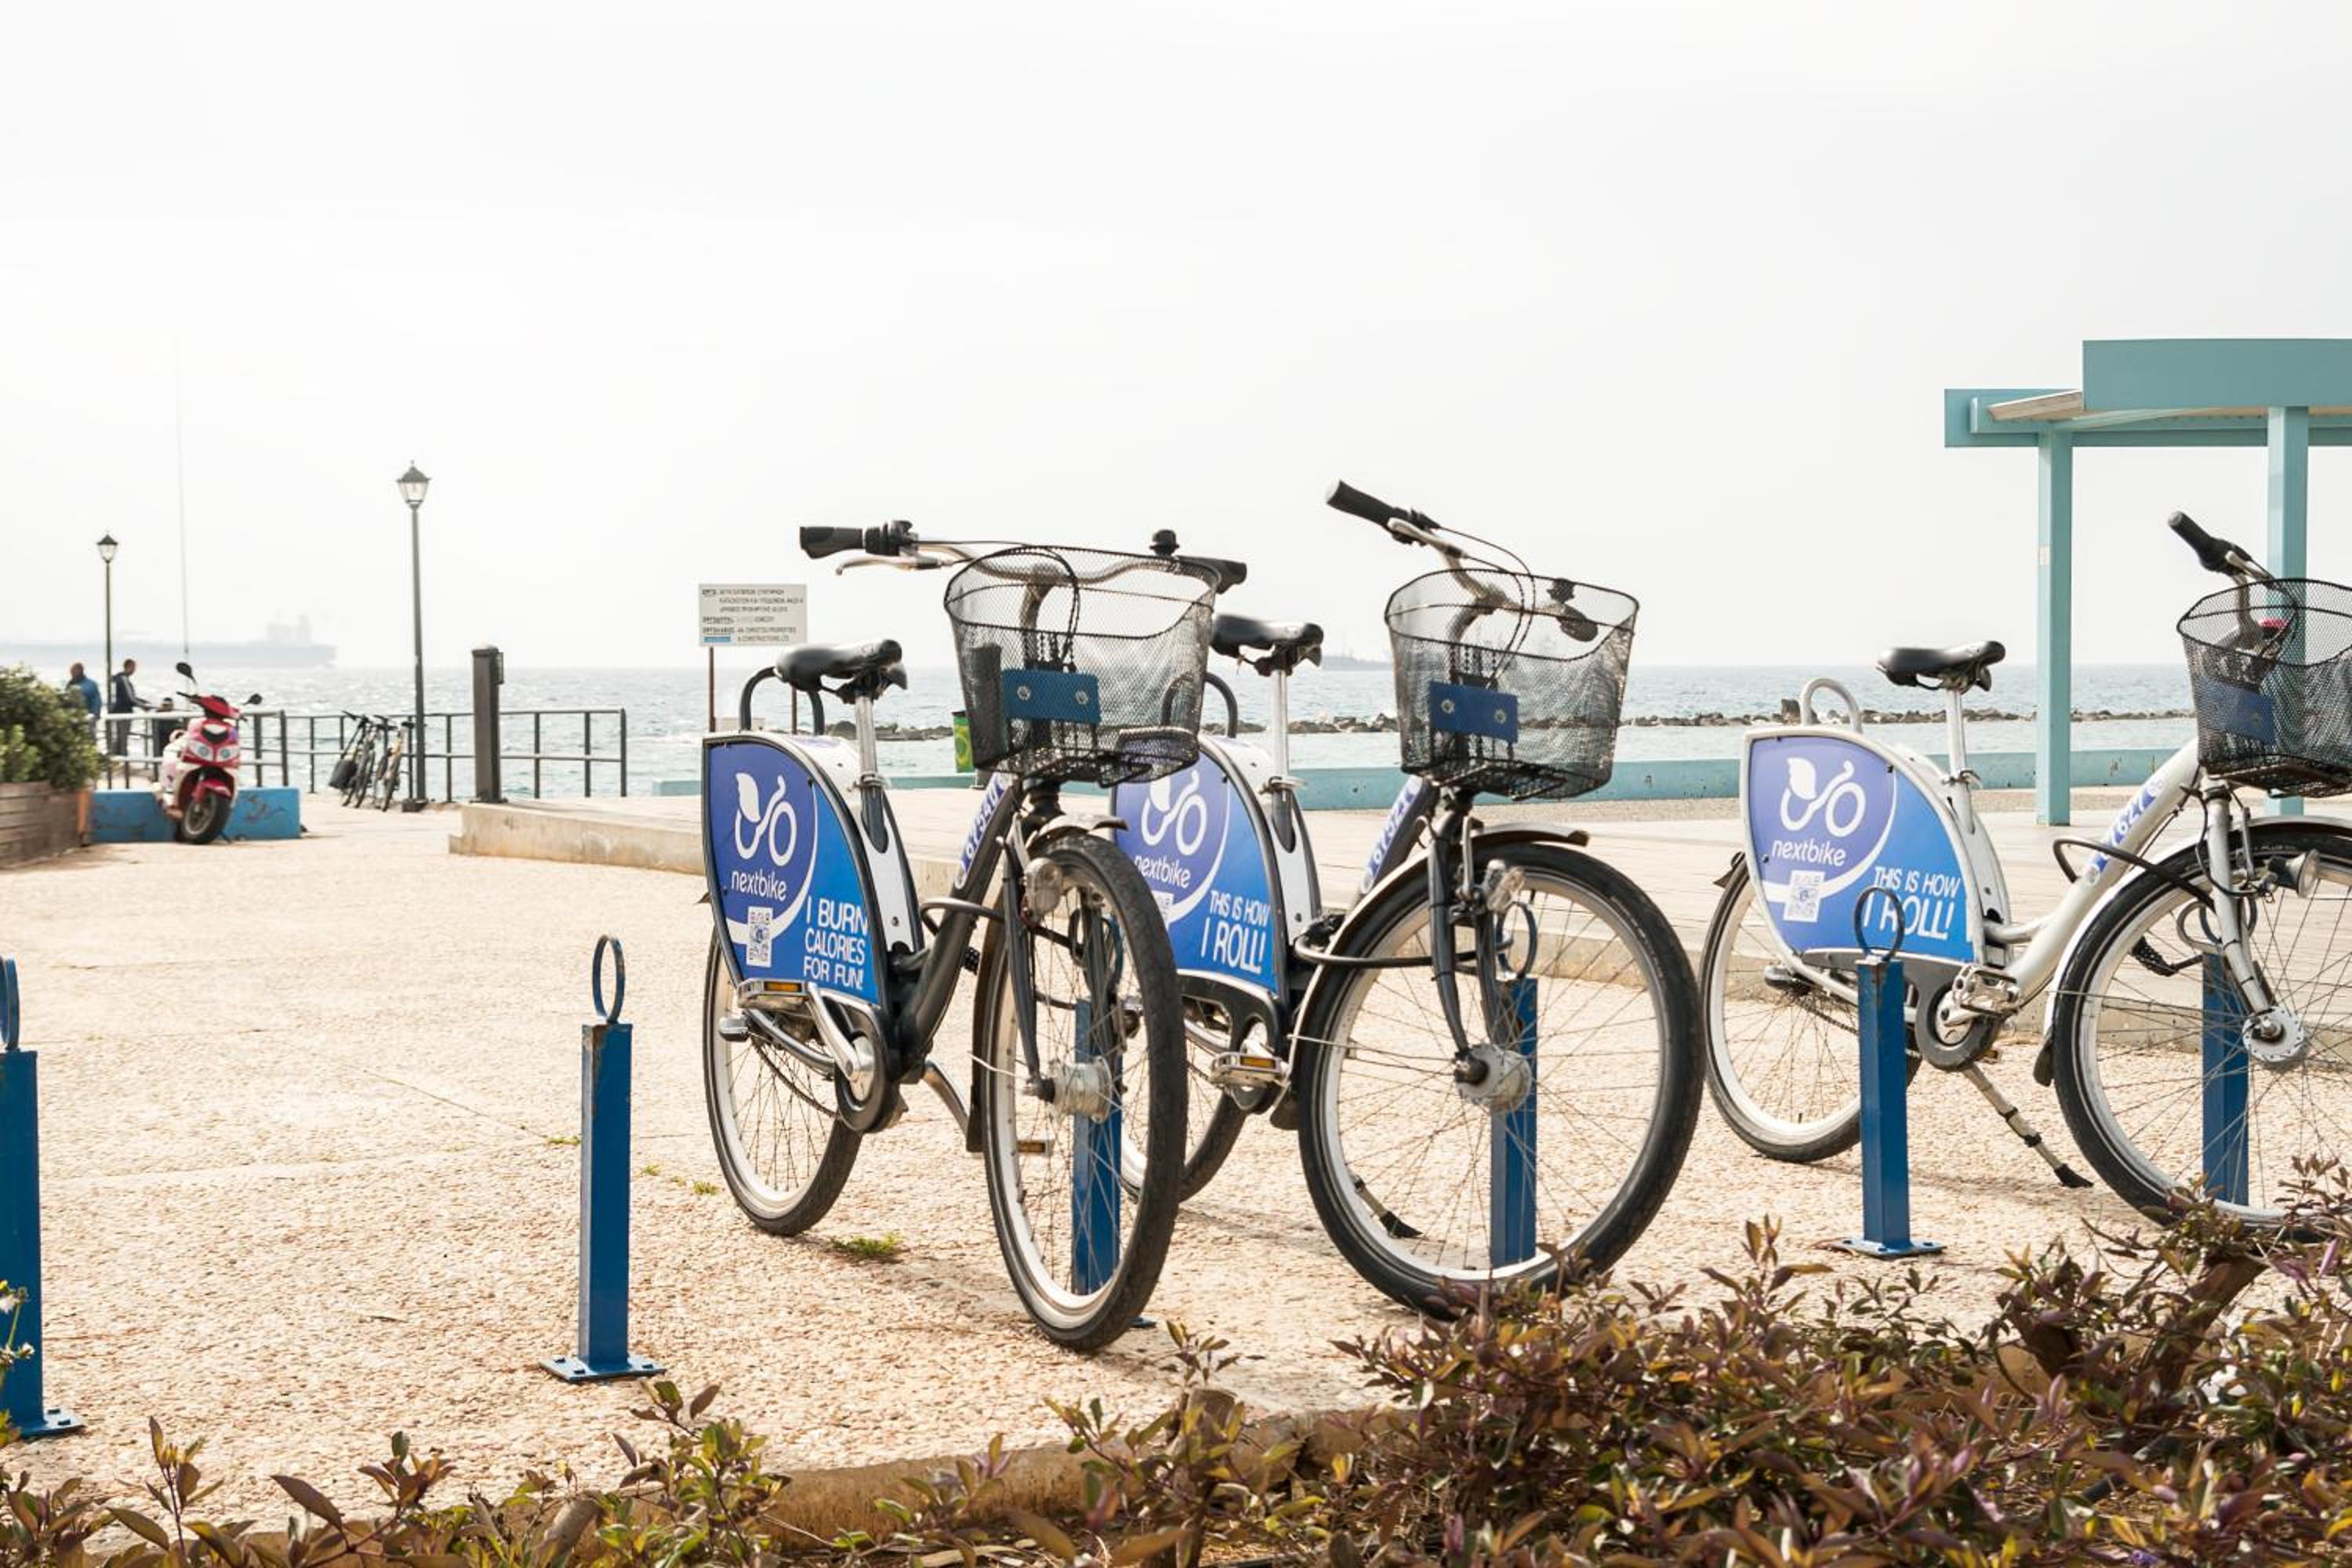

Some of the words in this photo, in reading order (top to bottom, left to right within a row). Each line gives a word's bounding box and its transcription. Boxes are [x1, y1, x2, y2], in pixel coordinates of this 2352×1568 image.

[1772, 838, 1846, 866] nextbike
[731, 868, 787, 901] nextbike
[1134, 855, 1191, 889] nextbike
[1875, 866, 1902, 891] THIS
[1904, 870, 1920, 893] IS
[1922, 873, 1960, 898] HOW
[806, 895, 812, 924] I
[818, 898, 868, 936] BURN
[1210, 890, 1232, 918] THIS
[1232, 896, 1243, 920] IS
[1243, 899, 1271, 927] HOW
[1864, 892, 1875, 927] I
[1879, 893, 1955, 941] ROLL!
[805, 927, 866, 966] CALORIES
[1201, 916, 1210, 957] I
[1213, 920, 1266, 974] ROLL!
[804, 956, 830, 982] FOR
[834, 963, 864, 991] FUN!
